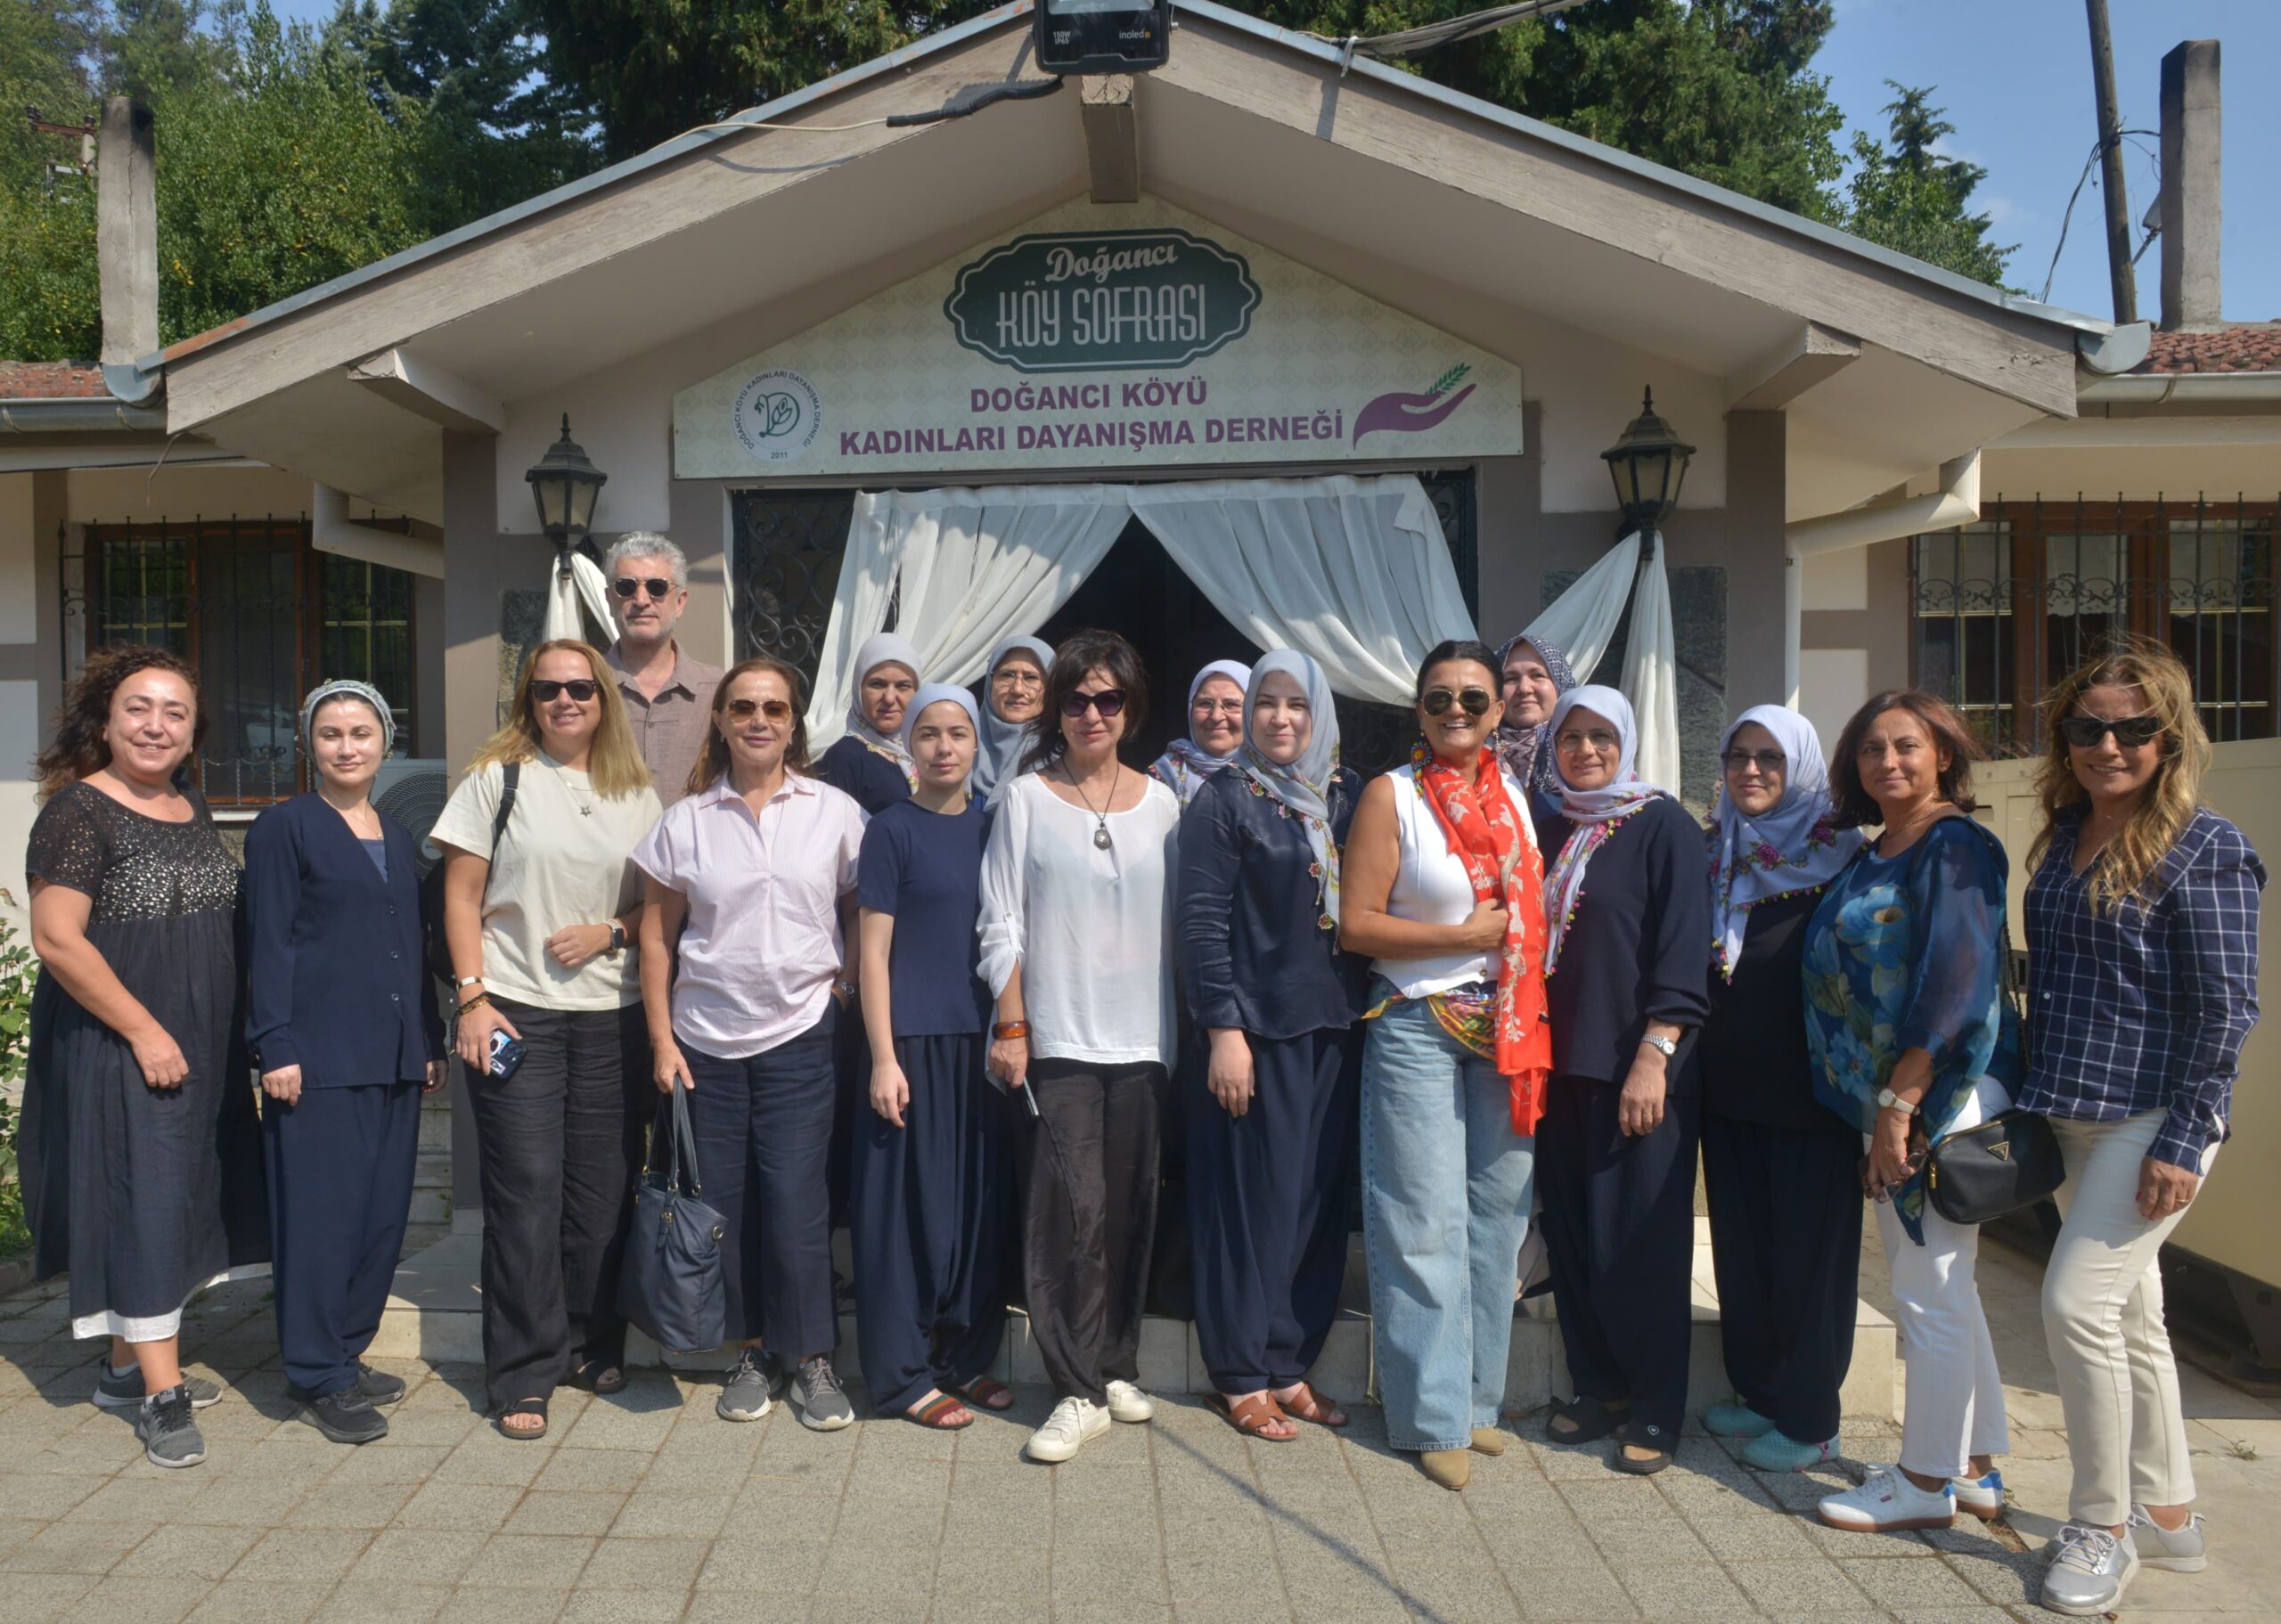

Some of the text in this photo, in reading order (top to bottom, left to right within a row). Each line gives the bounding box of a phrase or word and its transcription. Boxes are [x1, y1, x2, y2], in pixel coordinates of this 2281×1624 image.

[1119, 29, 1145, 39] inoled
[1045, 244, 1178, 282] Doğancı
[996, 281, 1206, 348] KÖY SOFRASI
[970, 376, 1208, 412] DOĞANCI KÖYÜ
[840, 409, 1344, 455] KADINLARI DAYANIŞMA DERNEĞİ
[770, 452, 788, 460] 2011
